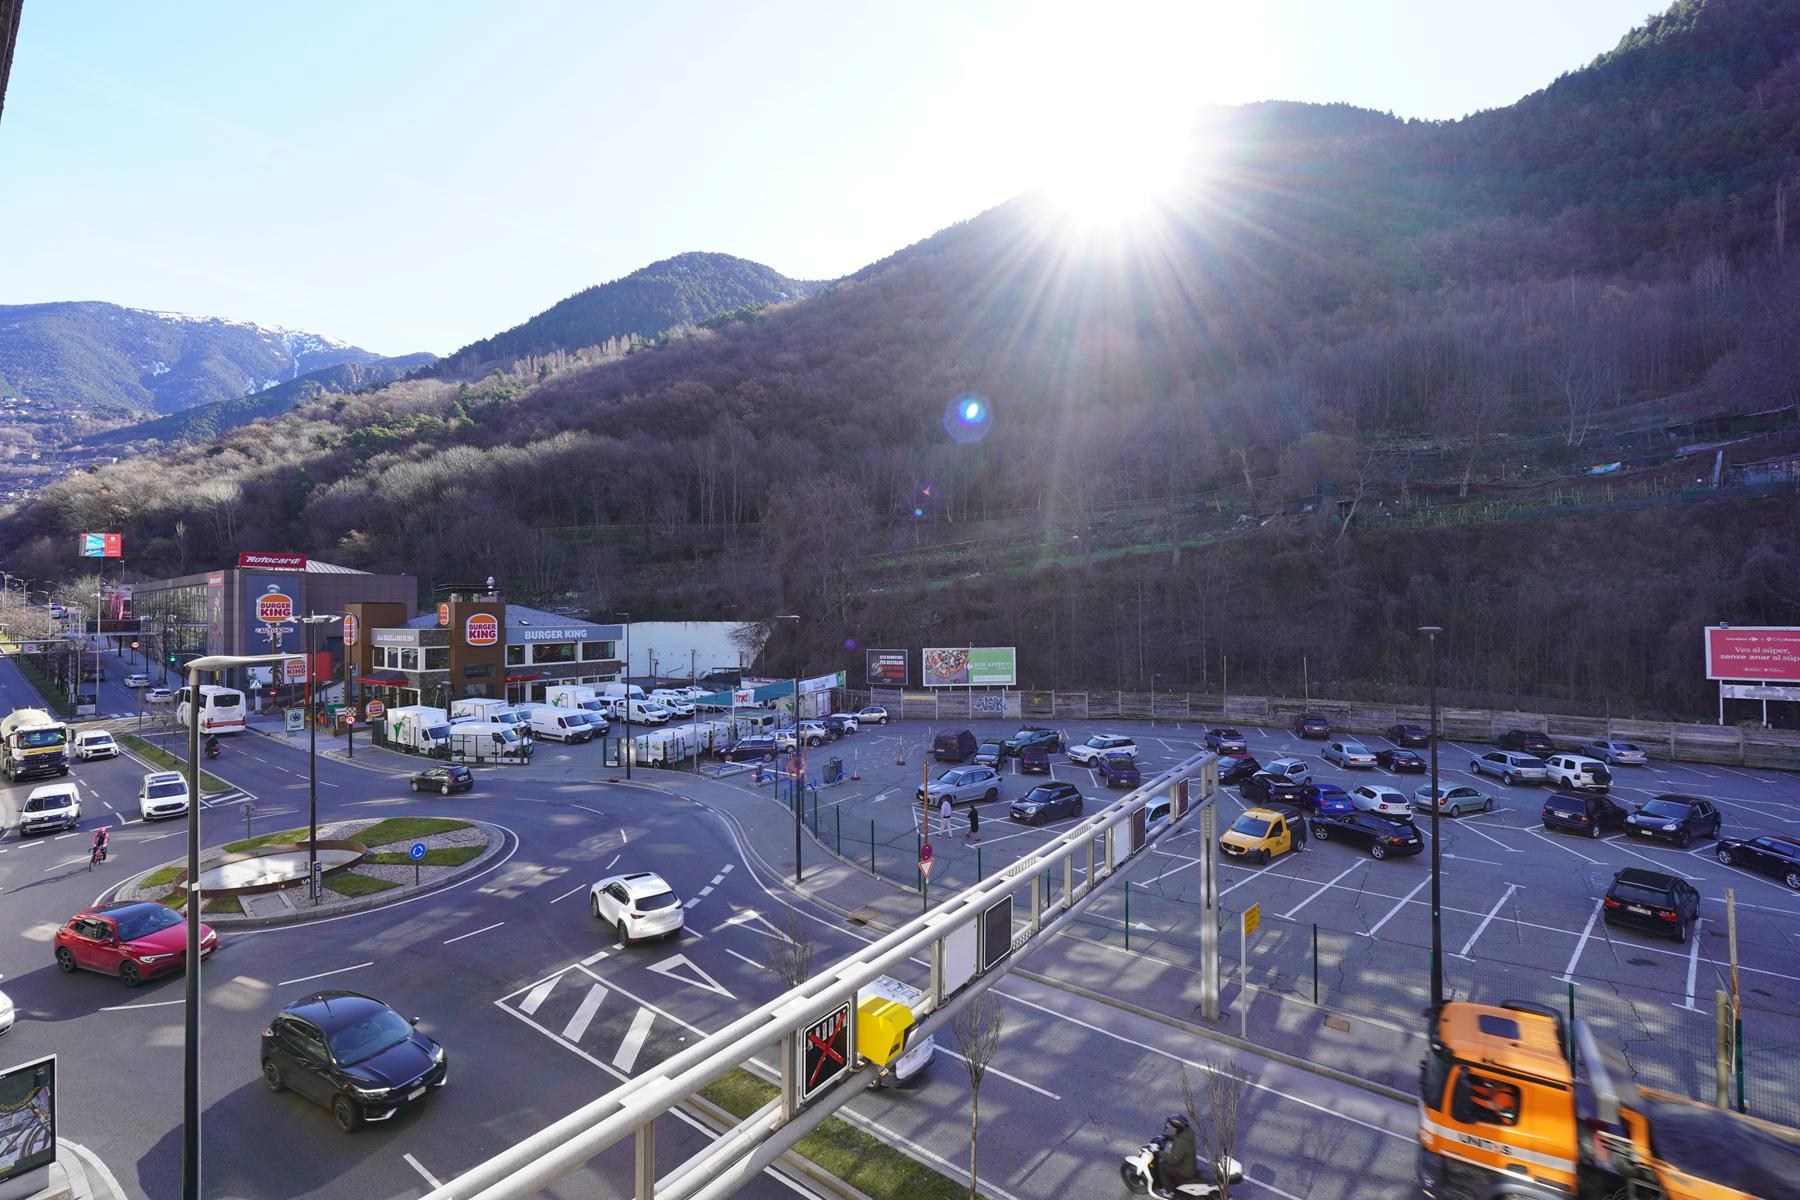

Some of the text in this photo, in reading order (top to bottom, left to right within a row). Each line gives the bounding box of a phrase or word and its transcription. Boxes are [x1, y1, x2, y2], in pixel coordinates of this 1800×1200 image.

[469, 630, 496, 638] KING
[524, 629, 588, 640] BURGER KING
